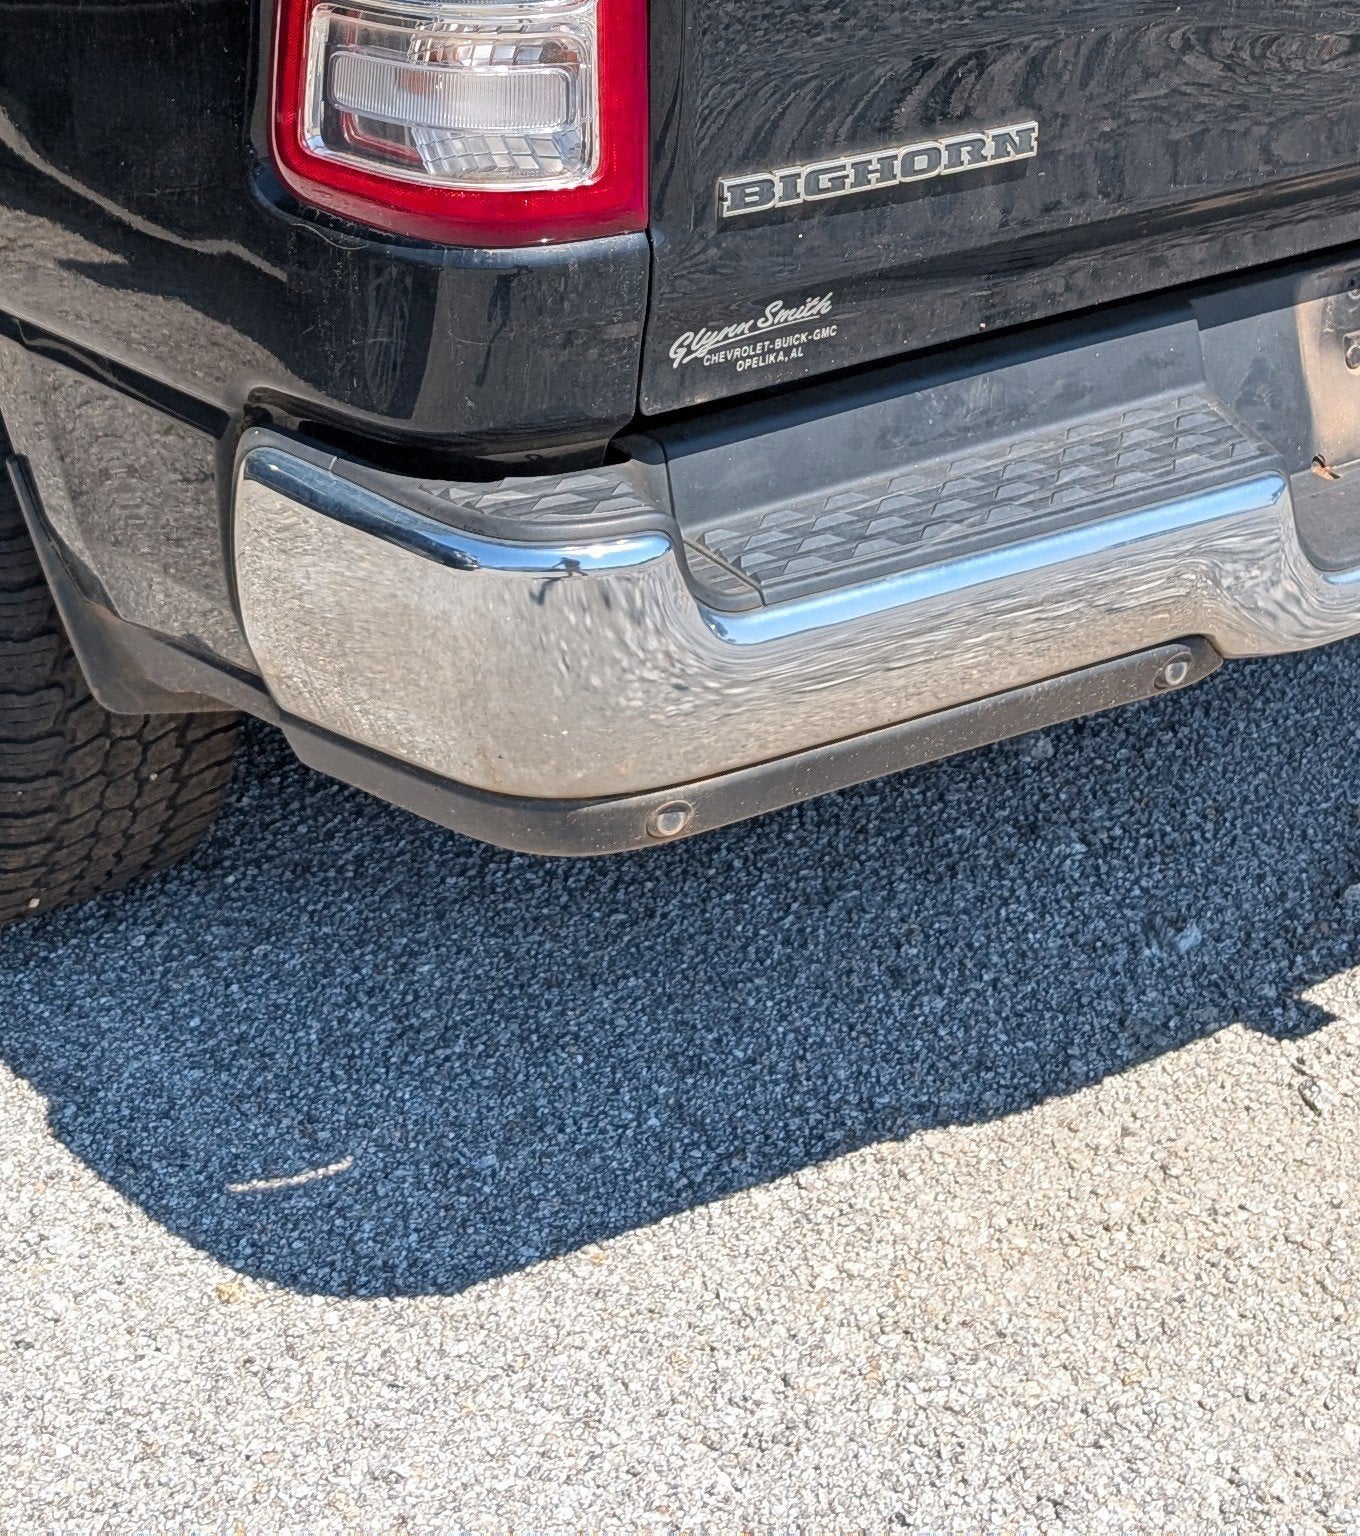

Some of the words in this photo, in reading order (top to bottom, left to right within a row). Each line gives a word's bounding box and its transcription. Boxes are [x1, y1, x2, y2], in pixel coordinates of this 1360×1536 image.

[720, 120, 1039, 218] BIGHORN
[668, 318, 755, 369] Glynn
[756, 291, 834, 329] Smith
[702, 324, 838, 367] CHEVROLET-BUICK-GMC
[736, 351, 789, 372] OPELIKA,
[790, 346, 804, 359] AL
